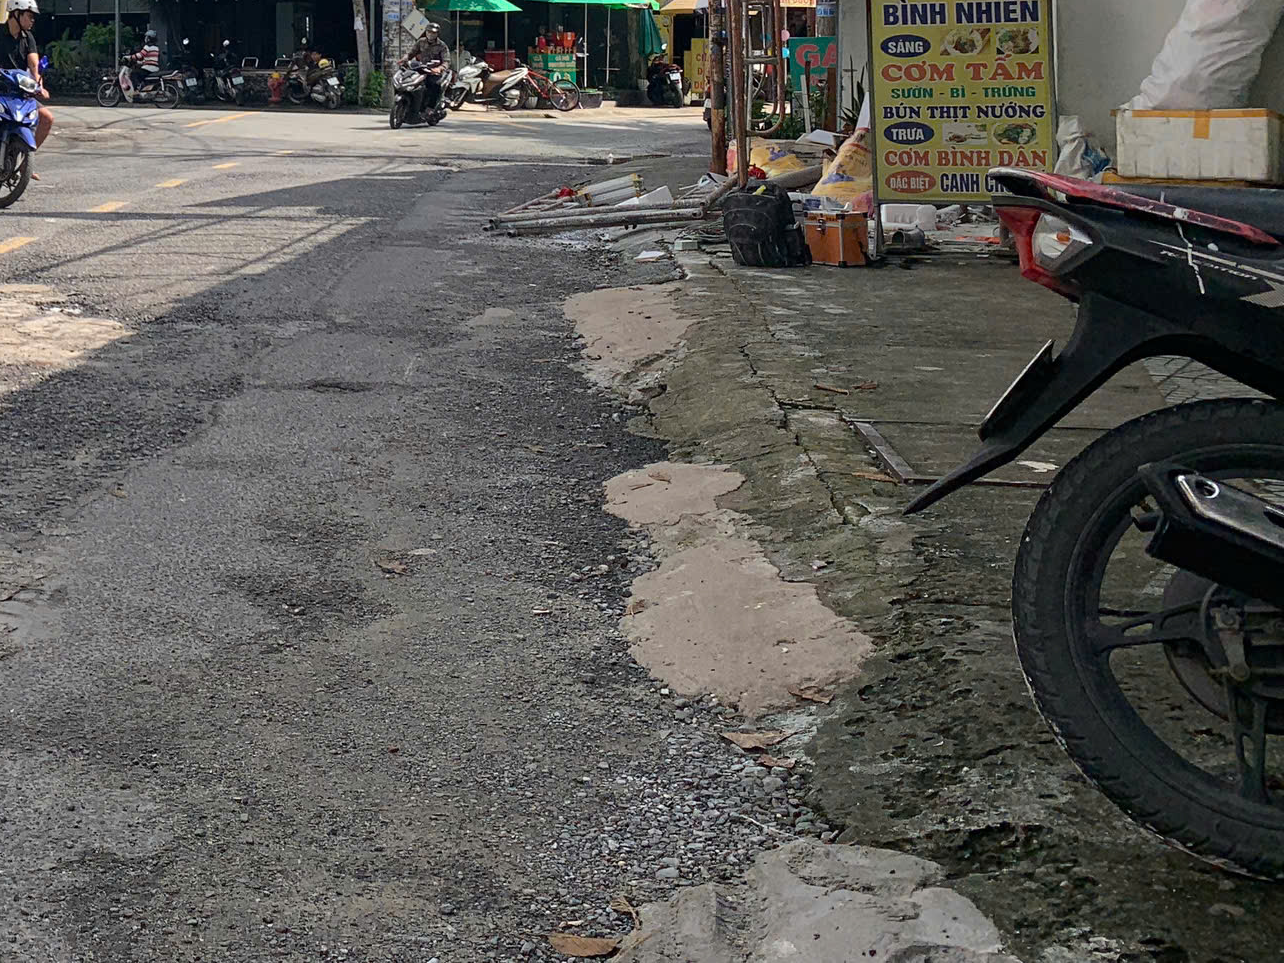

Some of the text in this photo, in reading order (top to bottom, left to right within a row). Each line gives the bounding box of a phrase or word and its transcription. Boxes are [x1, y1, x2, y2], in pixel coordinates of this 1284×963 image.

[883, 0, 947, 26] BÌNH
[888, 38, 924, 54] SÁNG
[881, 53, 1045, 82] CƠM TẤM
[950, 84, 966, 99] BÌ
[982, 84, 1036, 98] TRỨNG
[883, 101, 1046, 123] BÚN THỊT NƯỚNG
[891, 126, 925, 141] TRƯA
[884, 147, 930, 167] CƠM
[937, 146, 992, 167] BÌNH
[998, 145, 1048, 167] DÂN
[910, 173, 930, 192] BIỆT
[940, 173, 980, 193] CANH
